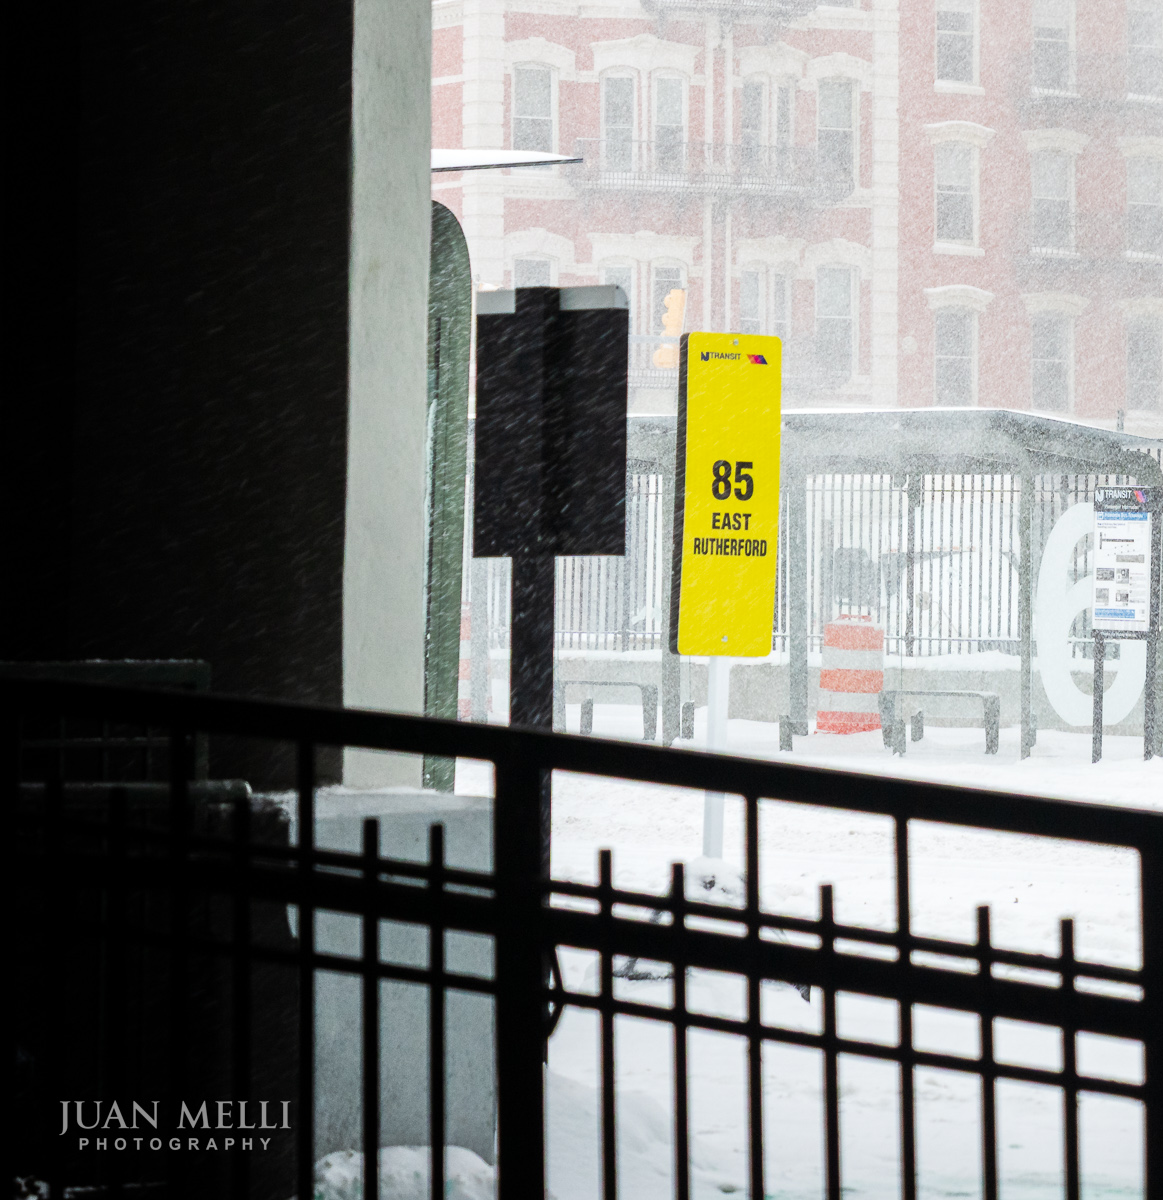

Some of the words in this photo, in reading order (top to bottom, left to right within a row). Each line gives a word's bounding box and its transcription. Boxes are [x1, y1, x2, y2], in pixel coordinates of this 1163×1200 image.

[709, 352, 741, 361] TRANSIT
[711, 459, 754, 501] 85
[1105, 490, 1132, 499] TRANSIT
[711, 512, 752, 531] EAST
[693, 537, 767, 557] RUTHERFORD
